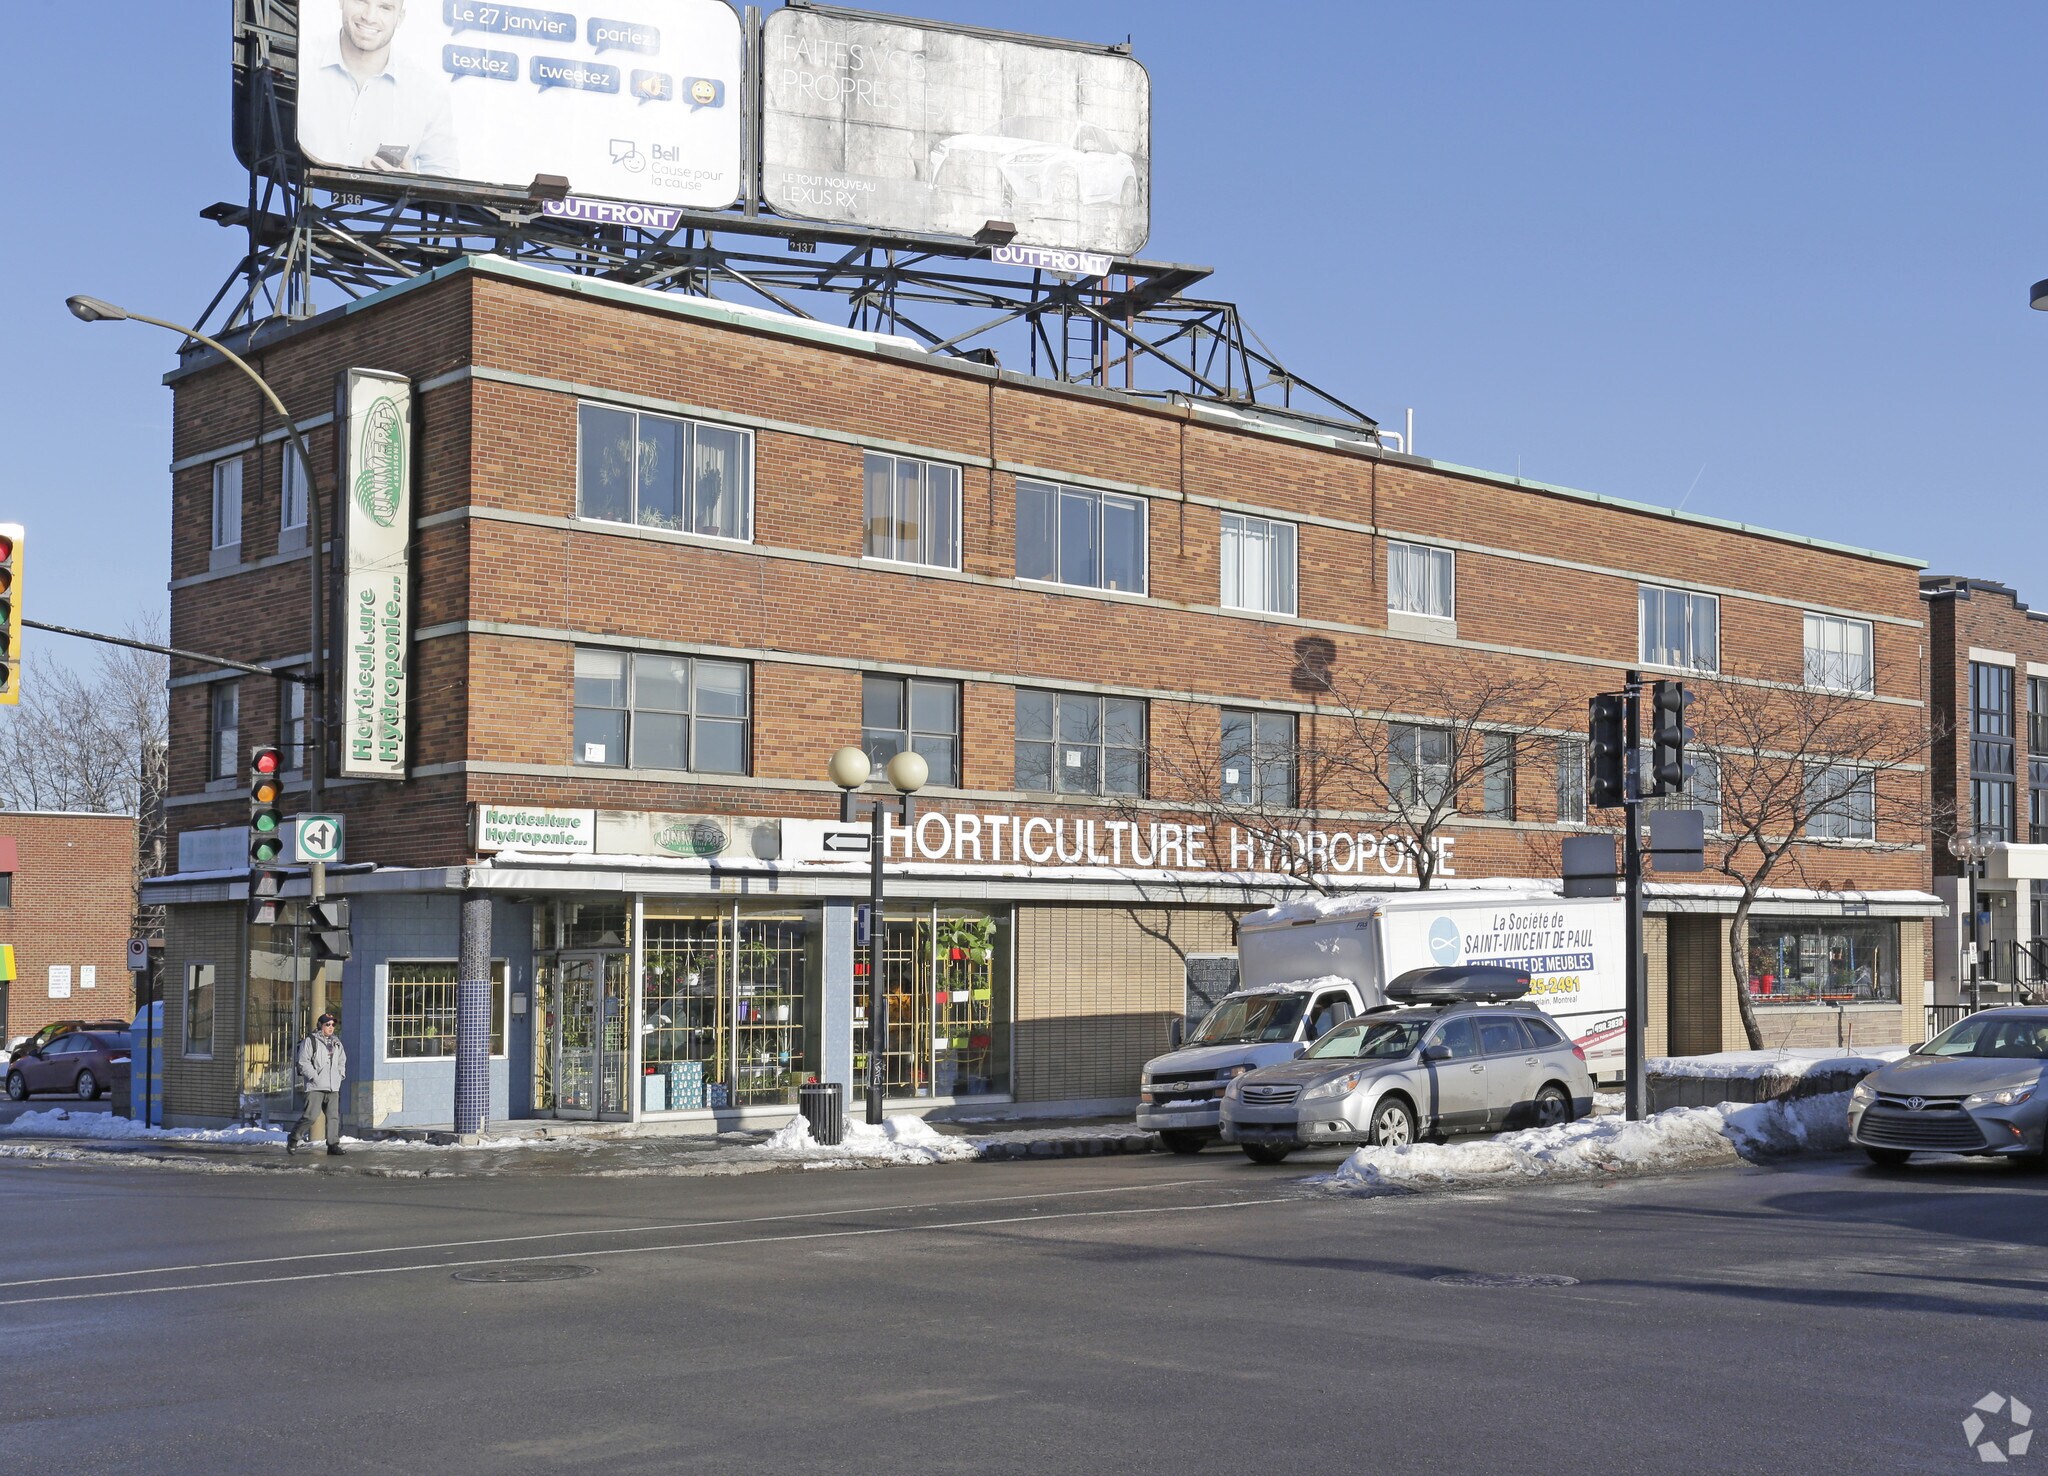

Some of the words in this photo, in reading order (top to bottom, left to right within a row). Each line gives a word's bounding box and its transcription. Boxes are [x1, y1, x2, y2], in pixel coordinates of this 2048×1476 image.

[453, 3, 474, 22] Le
[479, 7, 499, 25] 27
[502, 11, 567, 34] janvier
[596, 26, 650, 46] parlez
[452, 52, 509, 74] textez
[783, 34, 864, 71] FAITES
[870, 46, 926, 80] VOS
[539, 63, 610, 86] tweetez
[782, 68, 901, 110] PROPRES
[652, 143, 680, 162] Bell
[651, 162, 691, 178] Cause
[694, 169, 724, 182] pour
[652, 174, 662, 186] la
[665, 177, 702, 191] cause
[782, 172, 794, 183] LE
[796, 174, 822, 186] TOUT
[824, 177, 876, 192] NOUVEAU
[332, 192, 362, 205] 2136
[782, 185, 832, 206] LEXUS
[836, 191, 857, 209] RX
[547, 198, 675, 227] OUTFRONT
[995, 246, 1107, 275] OUTFRONT
[373, 411, 396, 517] UNIVERT
[485, 810, 582, 829] Horticulture
[883, 811, 1207, 868] HORTICULTURE
[1493, 913, 1506, 931] La
[1508, 912, 1549, 930] Société
[1551, 911, 1564, 928] de
[1464, 931, 1551, 954] SAINT-VINCENT
[1552, 930, 1565, 949] DE
[1567, 929, 1594, 948] PAUL
[1531, 957, 1545, 973] DE
[1546, 955, 1590, 972] MEUBLES
